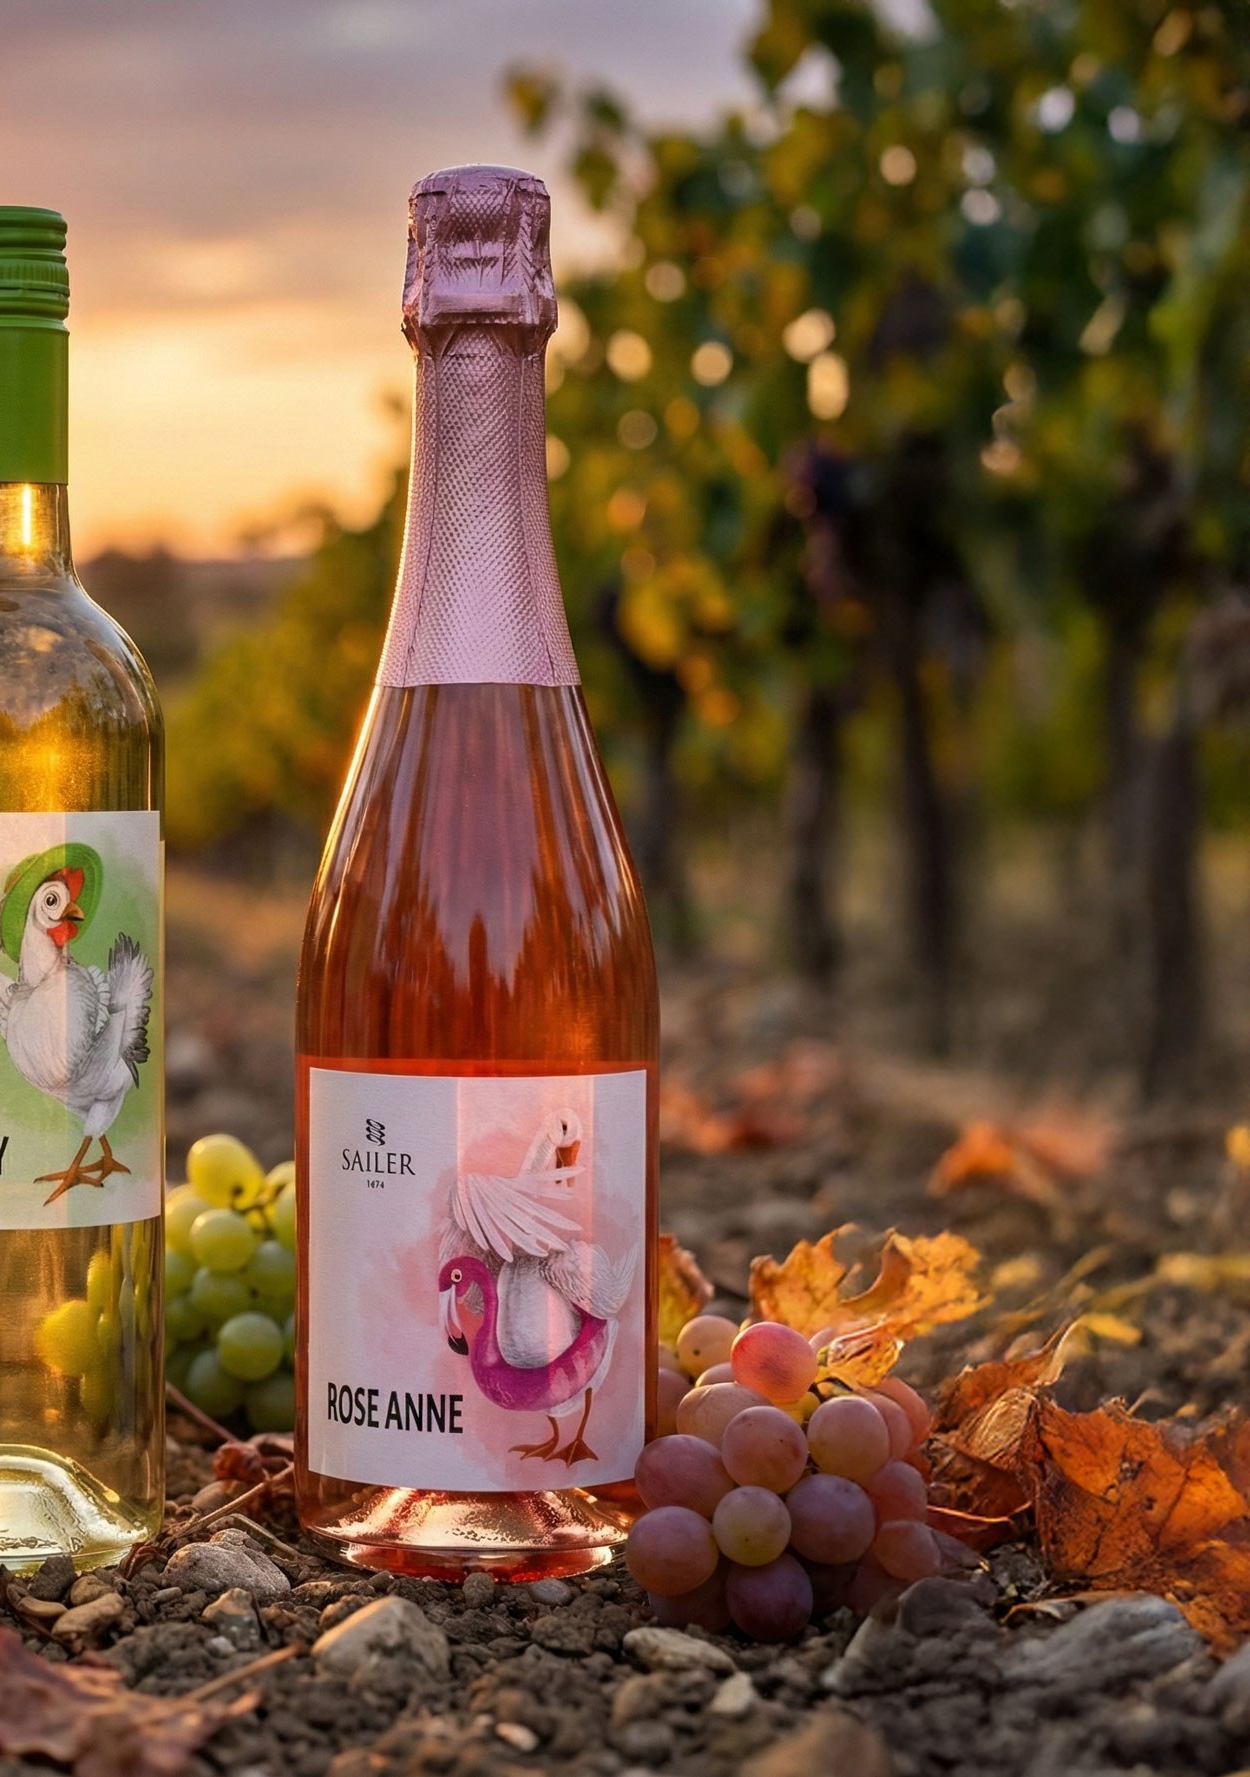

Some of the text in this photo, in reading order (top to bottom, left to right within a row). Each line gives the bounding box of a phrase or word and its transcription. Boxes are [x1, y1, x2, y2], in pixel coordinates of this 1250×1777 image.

[341, 1148, 416, 1176] SAILER
[327, 1381, 464, 1434] ROSE ANNE
